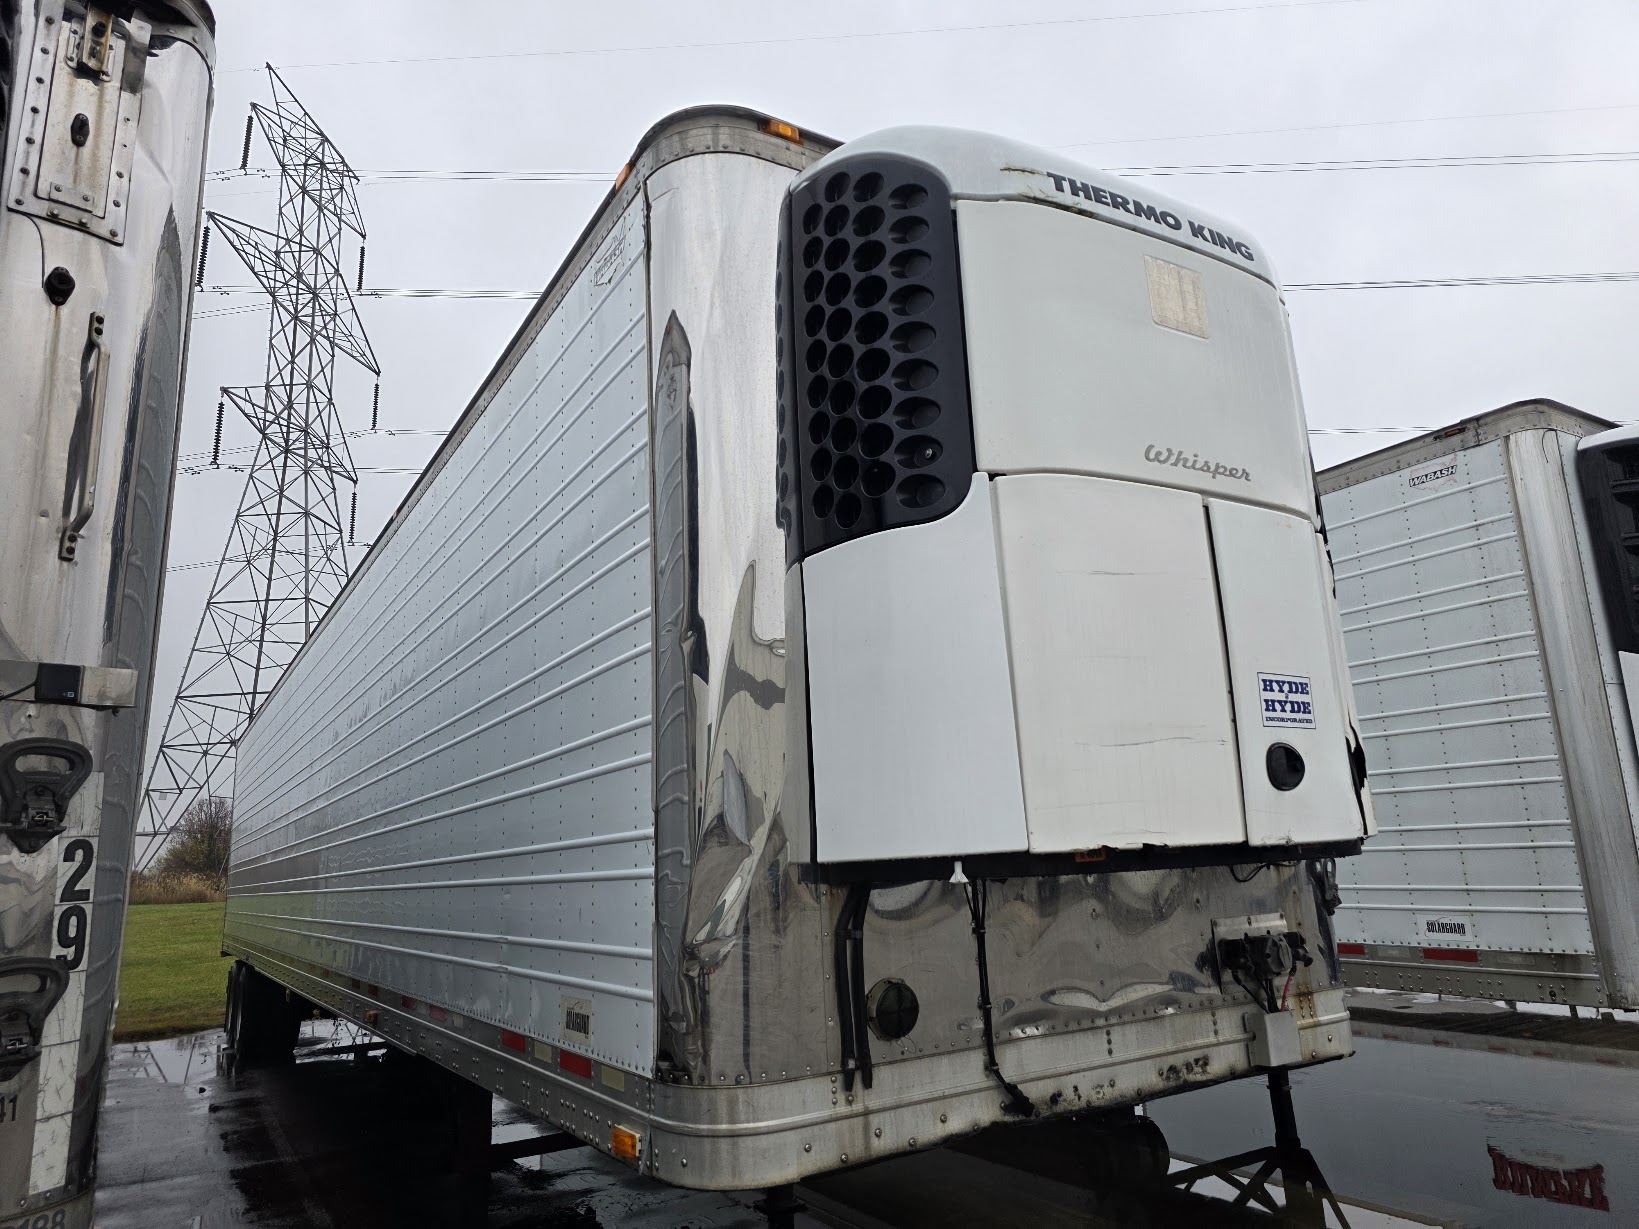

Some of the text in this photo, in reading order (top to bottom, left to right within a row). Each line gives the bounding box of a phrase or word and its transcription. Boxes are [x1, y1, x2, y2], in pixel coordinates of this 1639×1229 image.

[1047, 171, 1254, 261] THERMO KING
[1144, 444, 1251, 482] Whisper
[1409, 465, 1457, 487] WABASH
[1261, 679, 1309, 695] HYDE
[1263, 699, 1311, 714] HYDE
[1426, 921, 1466, 935] SOLARGUARD
